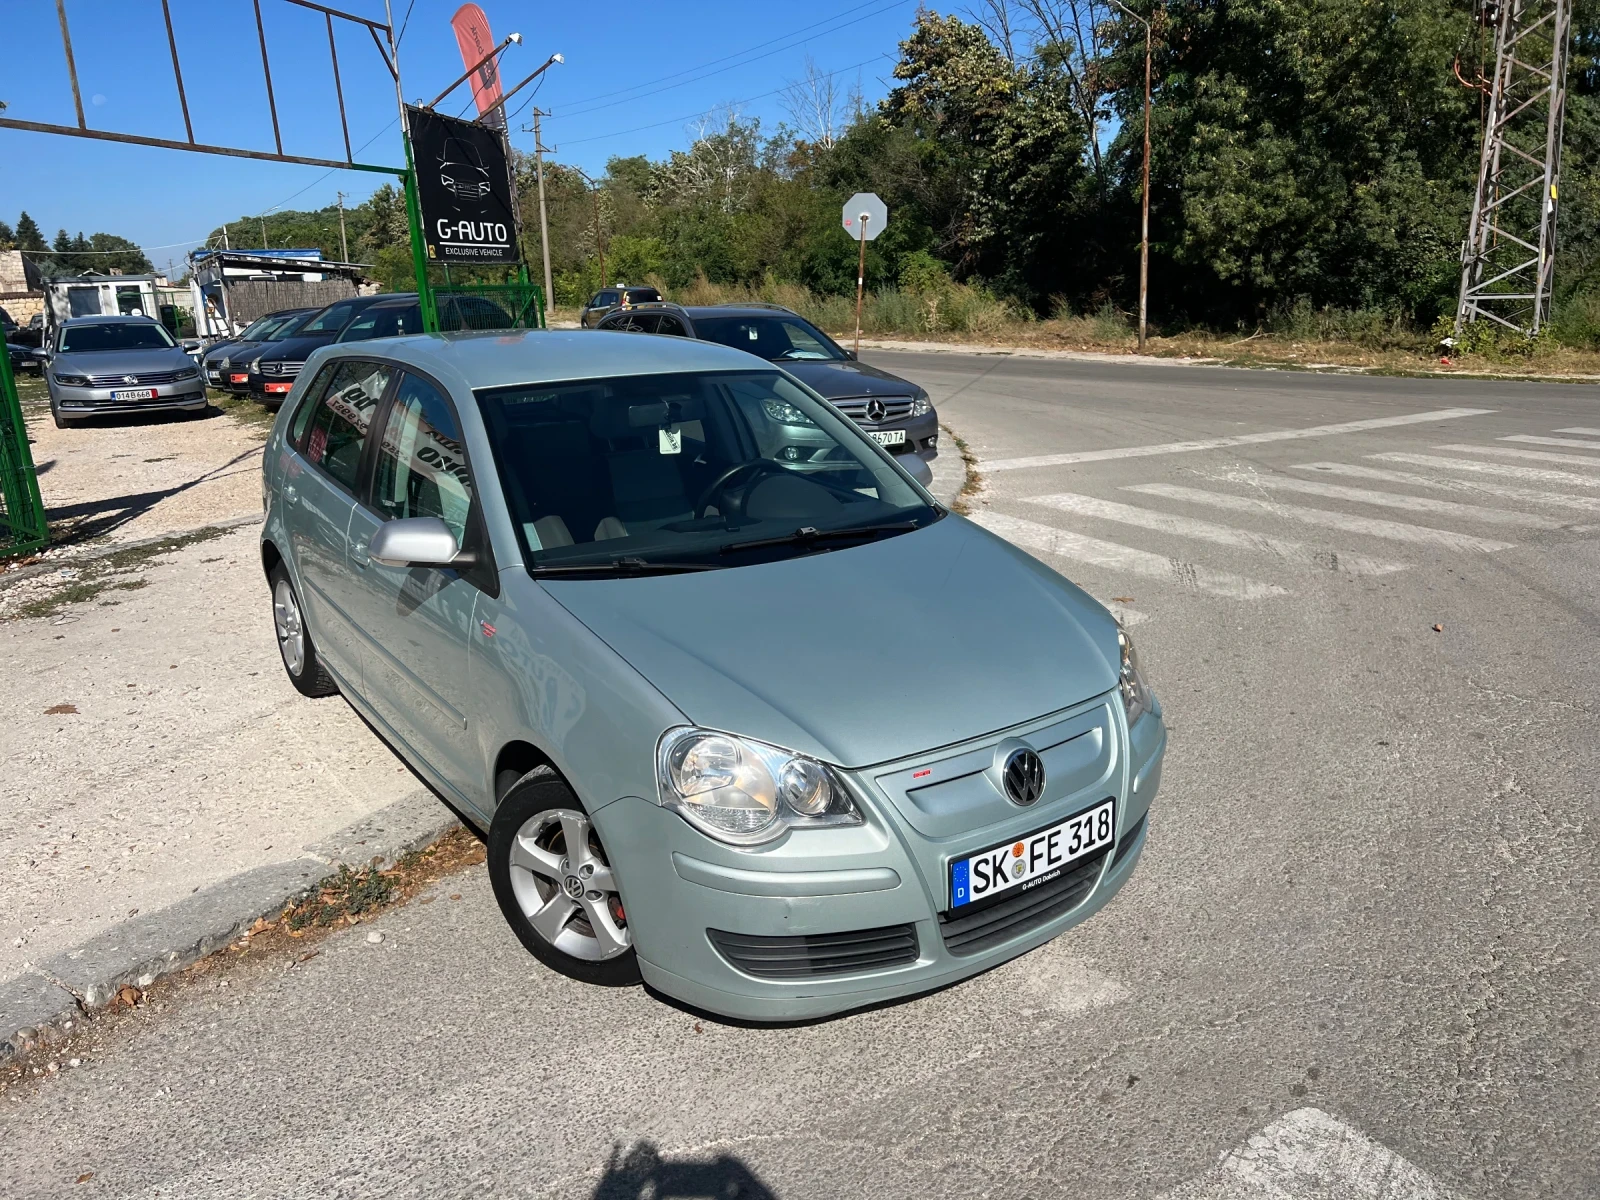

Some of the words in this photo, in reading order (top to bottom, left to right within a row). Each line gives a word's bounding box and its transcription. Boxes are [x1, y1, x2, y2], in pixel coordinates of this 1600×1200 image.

[437, 218, 507, 242] G-AUTO
[445, 247, 479, 256] EXCLUSIVE
[479, 248, 503, 257] VEHICLE
[894, 431, 904, 442] TA
[973, 850, 1010, 894] SK
[1029, 829, 1062, 873] FE
[1068, 808, 1110, 855] 318
[1022, 877, 1042, 890] G-AUTO
[957, 887, 965, 898] D
